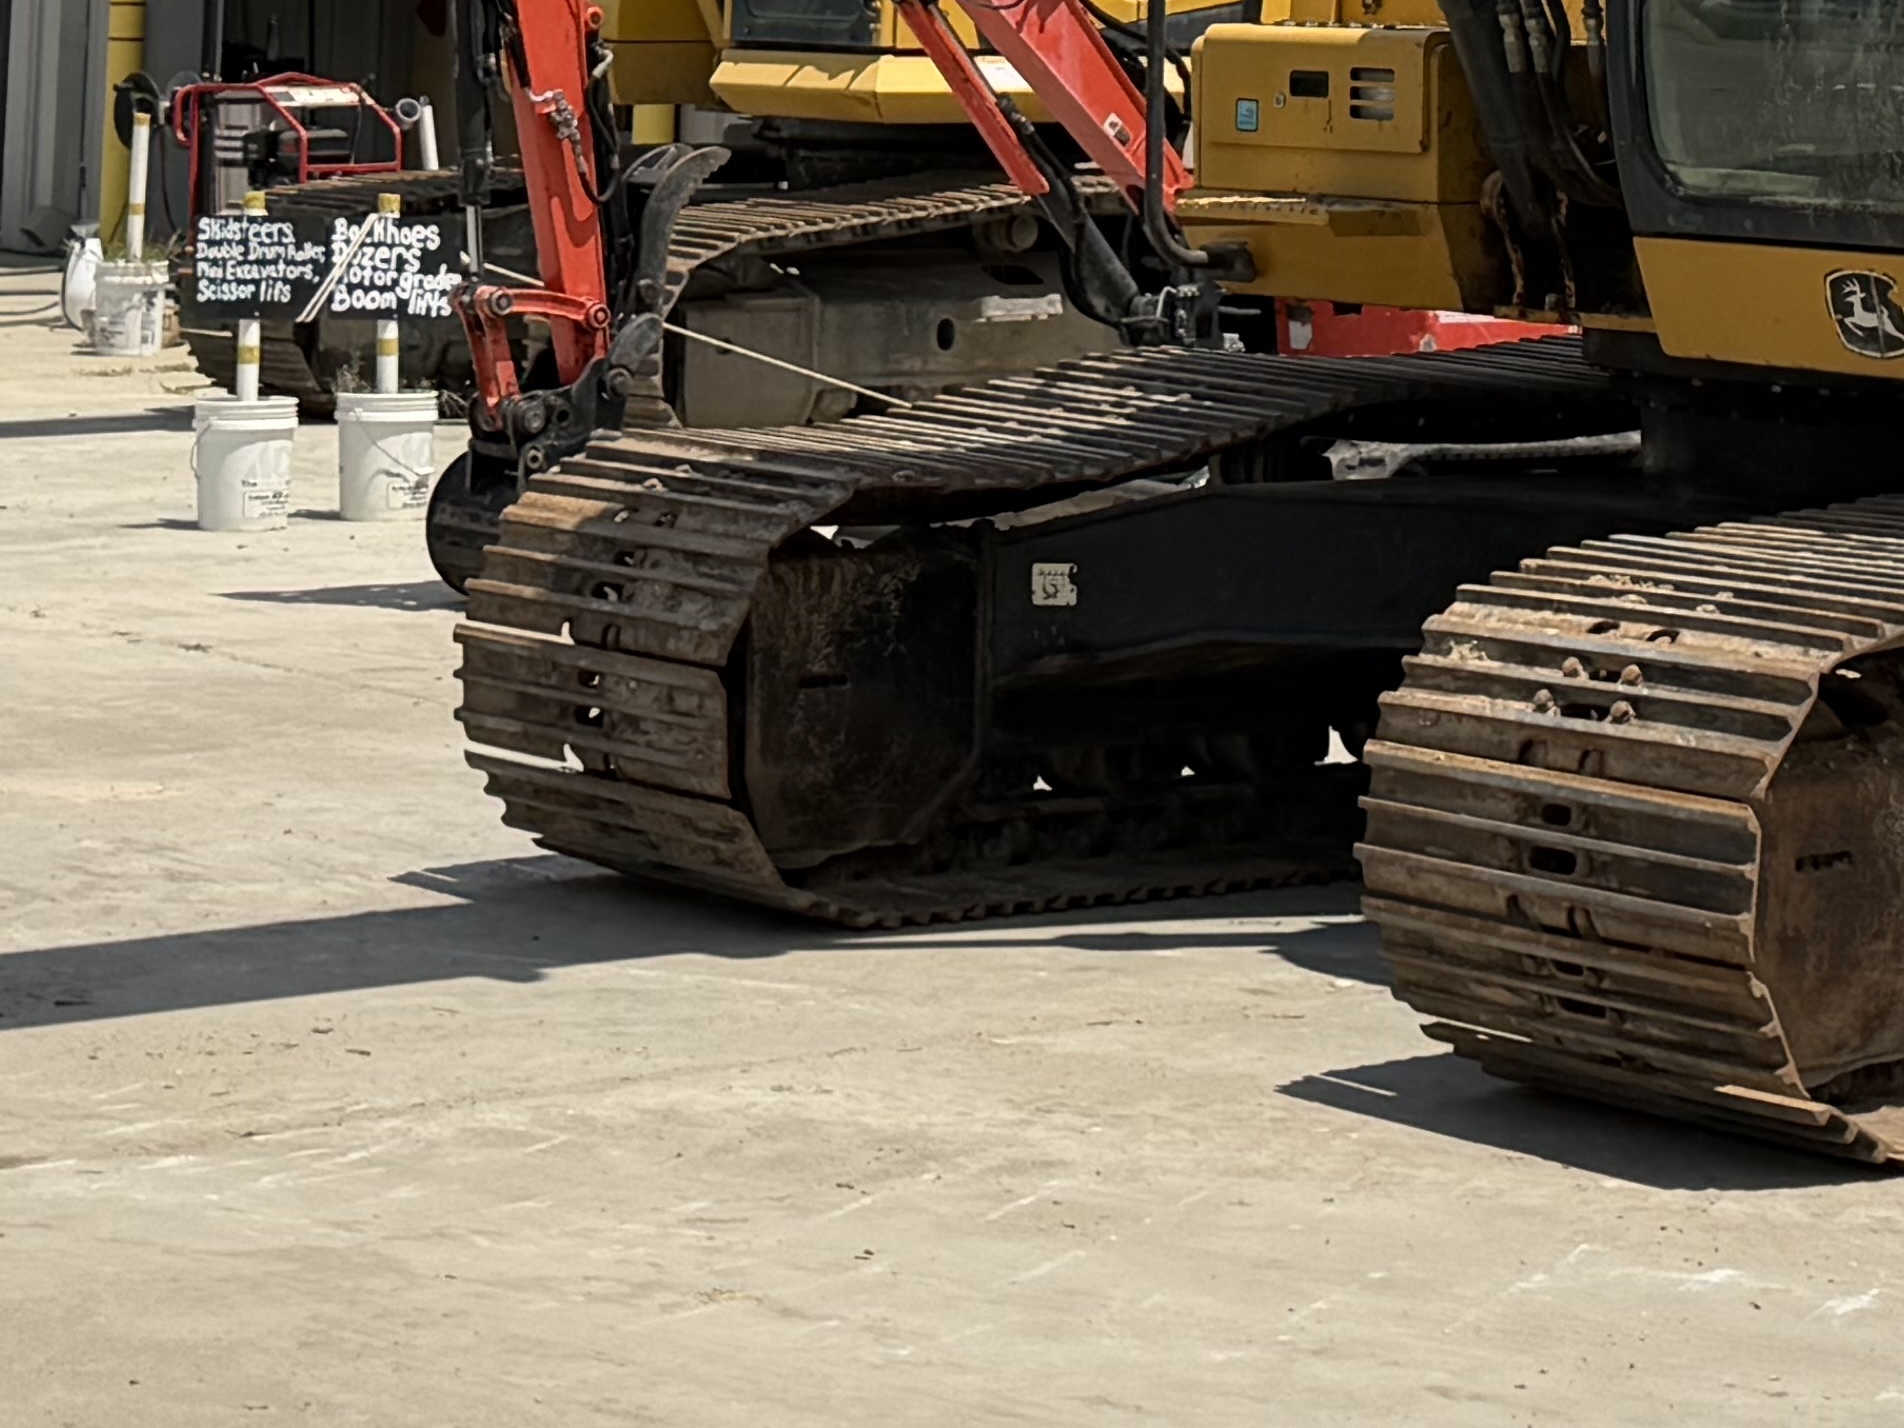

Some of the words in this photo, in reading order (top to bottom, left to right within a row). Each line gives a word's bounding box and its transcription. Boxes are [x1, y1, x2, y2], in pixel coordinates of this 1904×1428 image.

[196, 241, 245, 261] Double
[248, 241, 286, 261] Drum
[342, 265, 399, 286] otor
[196, 279, 256, 303] Scissor
[331, 283, 397, 312] Boom
